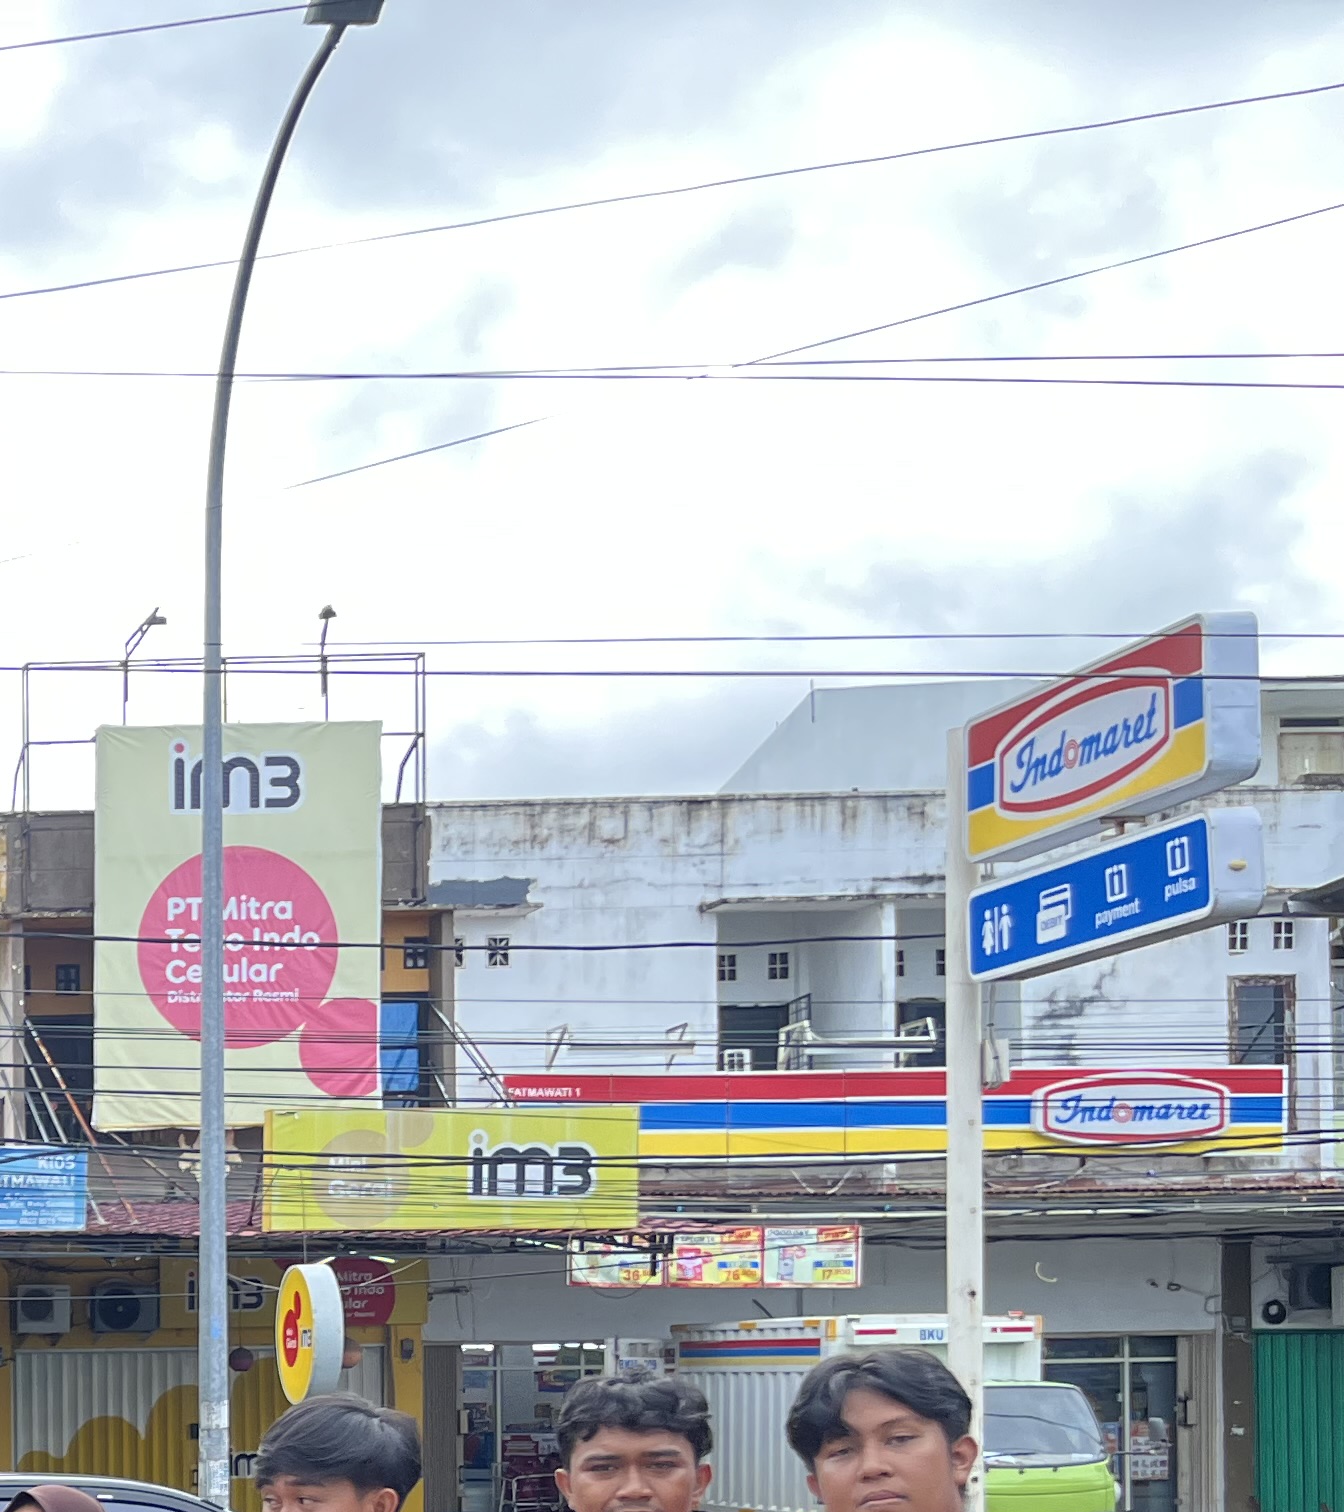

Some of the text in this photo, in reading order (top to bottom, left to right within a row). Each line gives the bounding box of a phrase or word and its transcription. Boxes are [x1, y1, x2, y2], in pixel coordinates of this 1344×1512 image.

[1010, 692, 1157, 793] Indomaret
[174, 743, 300, 810] im3
[1164, 876, 1197, 902] pulsa
[167, 897, 203, 921] PT
[1095, 897, 1140, 928] payment
[253, 925, 320, 951] Indo
[165, 957, 284, 983] Ceular
[253, 988, 299, 1002] Resmi
[508, 1087, 572, 1098] FATMAWATI
[1055, 1094, 1211, 1124] Indomaret
[472, 1133, 592, 1196] im3
[188, 1271, 263, 1310] i3
[919, 1328, 945, 1341] BKU
